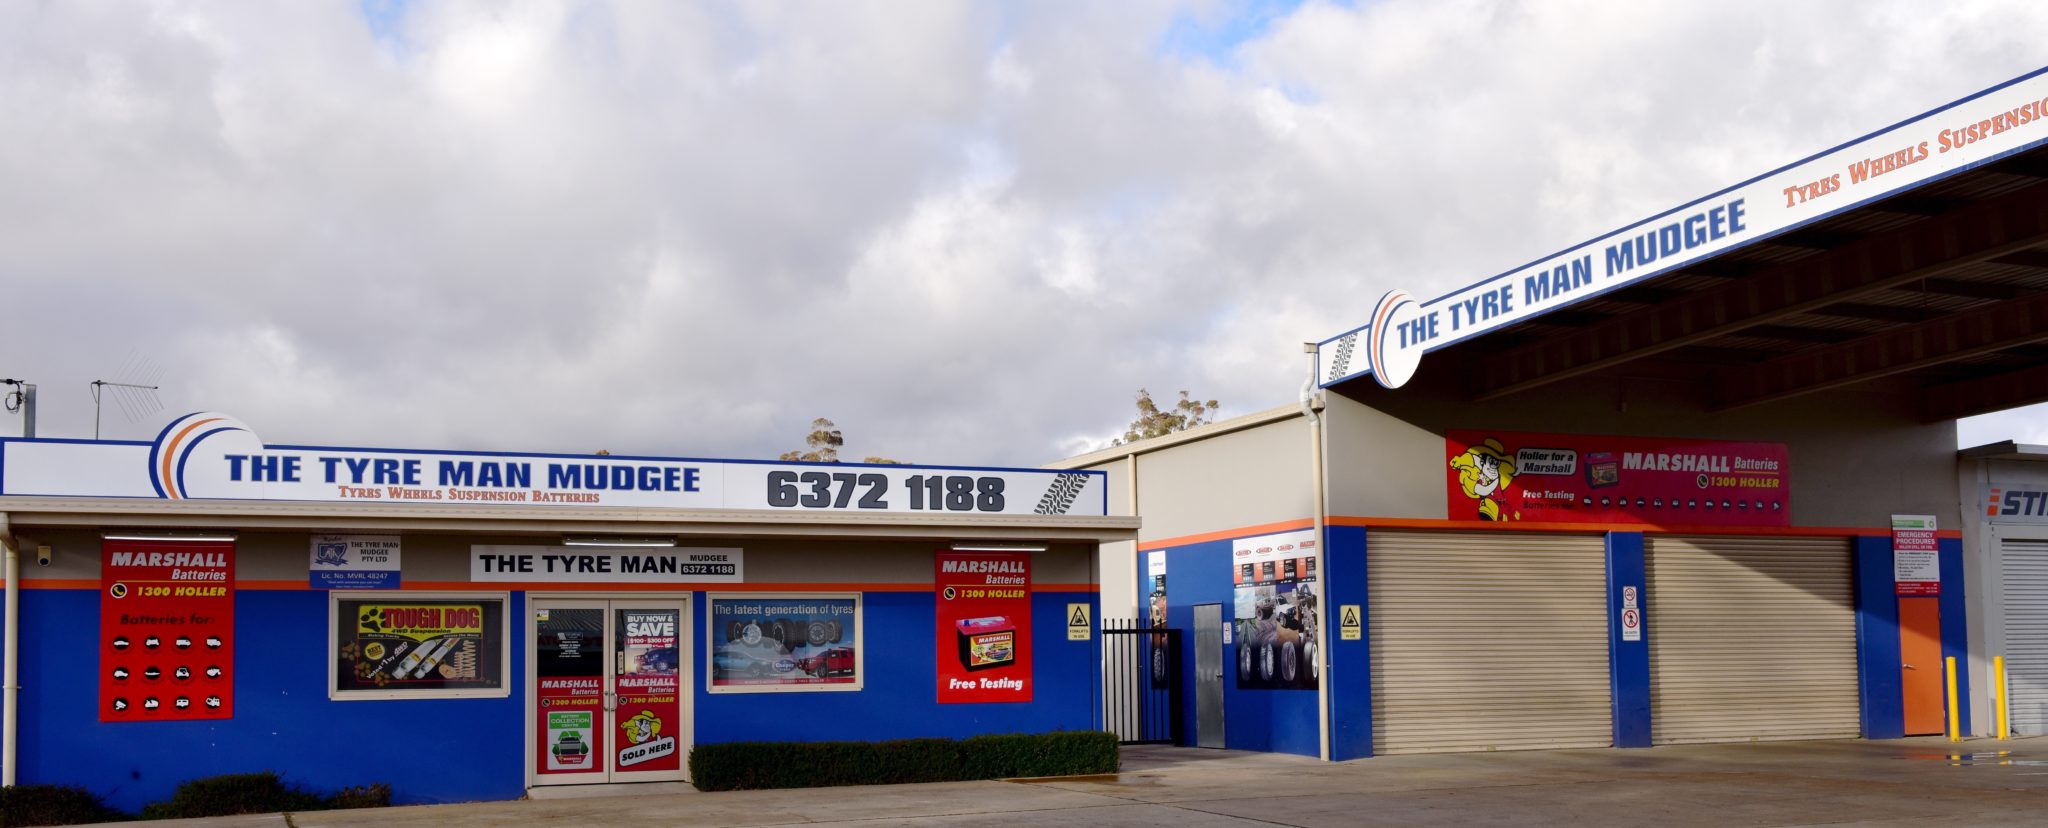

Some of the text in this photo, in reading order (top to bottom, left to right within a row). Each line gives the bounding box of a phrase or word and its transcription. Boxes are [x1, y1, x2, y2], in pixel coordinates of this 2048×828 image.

[1783, 173, 1841, 209] TYRES
[1848, 141, 1929, 185] WHEELS
[1396, 197, 1746, 350] THE TYRE MAN MUDGEE
[1519, 451, 1574, 461] Holler for a
[1523, 463, 1572, 473] Marshall
[1622, 452, 1779, 473] MARSHALL Batteries
[224, 454, 700, 492] THE TYRE MAN MUDGEE
[1711, 476, 1779, 488] 1300 HOLLER
[338, 485, 600, 503] TYRES WHEELS SUSPENSION BATTERIES
[767, 470, 1005, 512] 6372 1188
[1522, 489, 1575, 501] Free Testing
[2001, 491, 2048, 516] STI
[111, 551, 227, 567] MARSHALL
[480, 554, 677, 574] THE TYRE MAN
[689, 554, 728, 562] MUDGEE
[682, 565, 734, 574] 6372 1188
[942, 560, 1025, 573] MARSHALL
[172, 568, 227, 580] Batteries
[985, 574, 1025, 585] Batteries
[137, 586, 227, 597] 1300 HOLLER
[961, 589, 1025, 598] 1300 HOLLER
[714, 604, 854, 616] The latest generation of tyres
[120, 613, 186, 625] Batteries
[383, 607, 480, 629] TOUGH DOG
[626, 622, 674, 637] SAVE
[978, 634, 1011, 643] MARSHALL
[366, 664, 383, 679] Voted
[541, 679, 599, 688] MARSHALL
[618, 678, 675, 687] MARSHALL
[949, 677, 1023, 691] Free Testing
[621, 741, 673, 762] SOLD HERE
